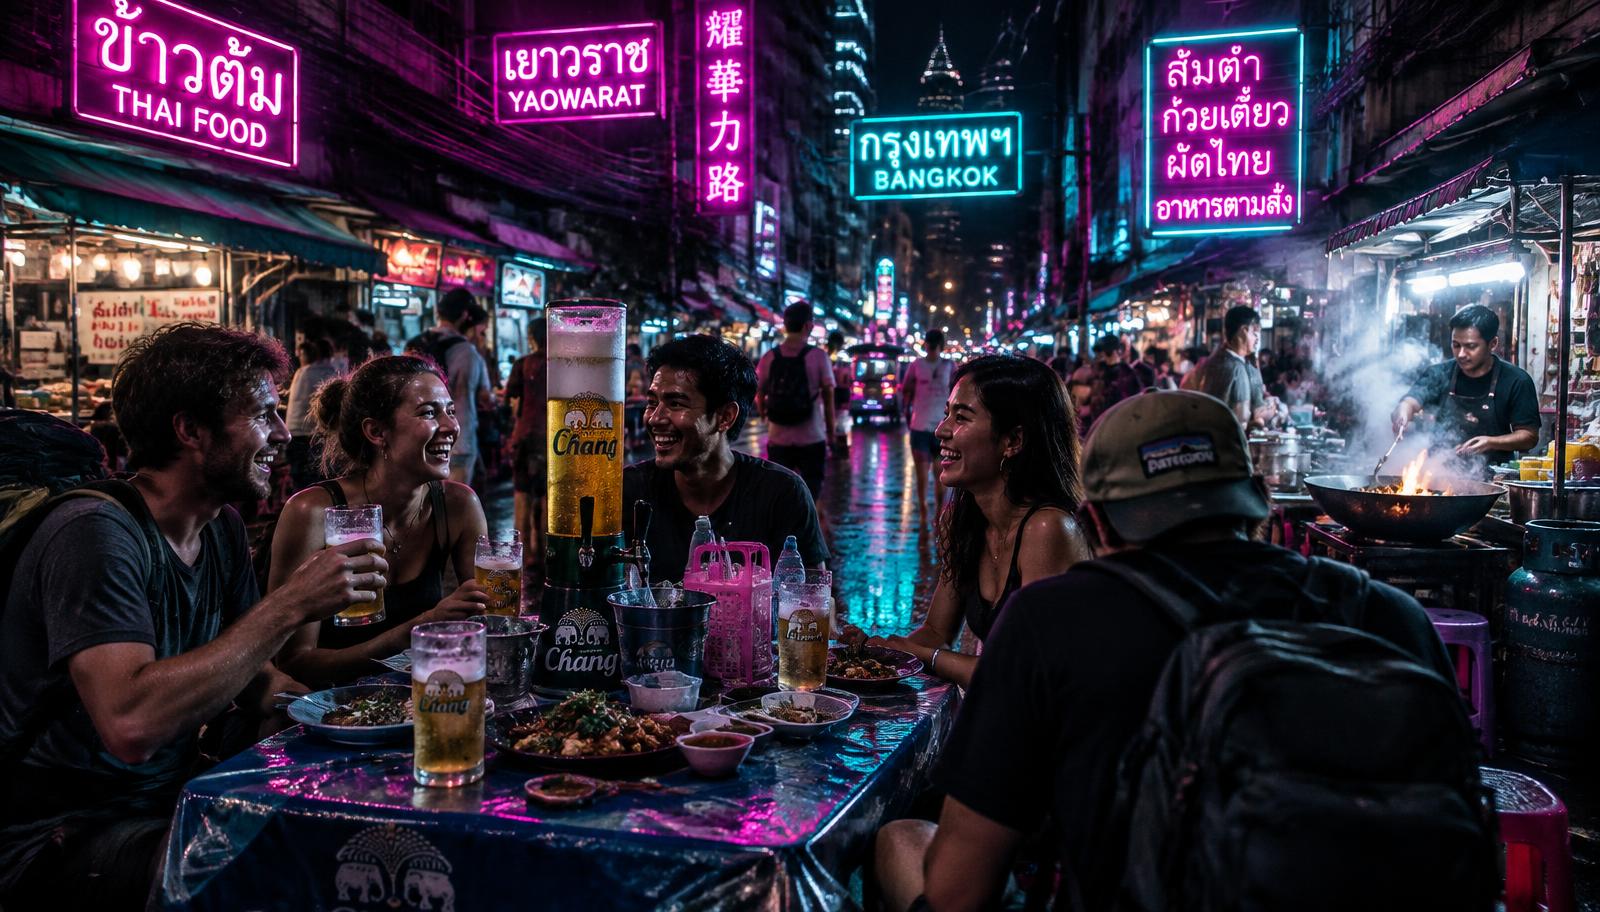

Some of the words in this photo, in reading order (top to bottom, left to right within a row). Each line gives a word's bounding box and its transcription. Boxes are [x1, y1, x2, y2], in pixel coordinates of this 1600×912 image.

[95, 0, 283, 116] ข้าวต้ม
[505, 37, 650, 81] เยาวราช
[1167, 45, 1260, 87] ส้มตำ
[112, 84, 181, 128] THAI
[194, 107, 267, 148] FOOD
[508, 84, 646, 113] YAOWARAT
[705, 9, 745, 202] 耀華力路
[860, 127, 1011, 168] กรุงเทพฯ
[875, 165, 998, 190] BANGKOK
[553, 428, 618, 461] Chang
[545, 647, 619, 677] Chang
